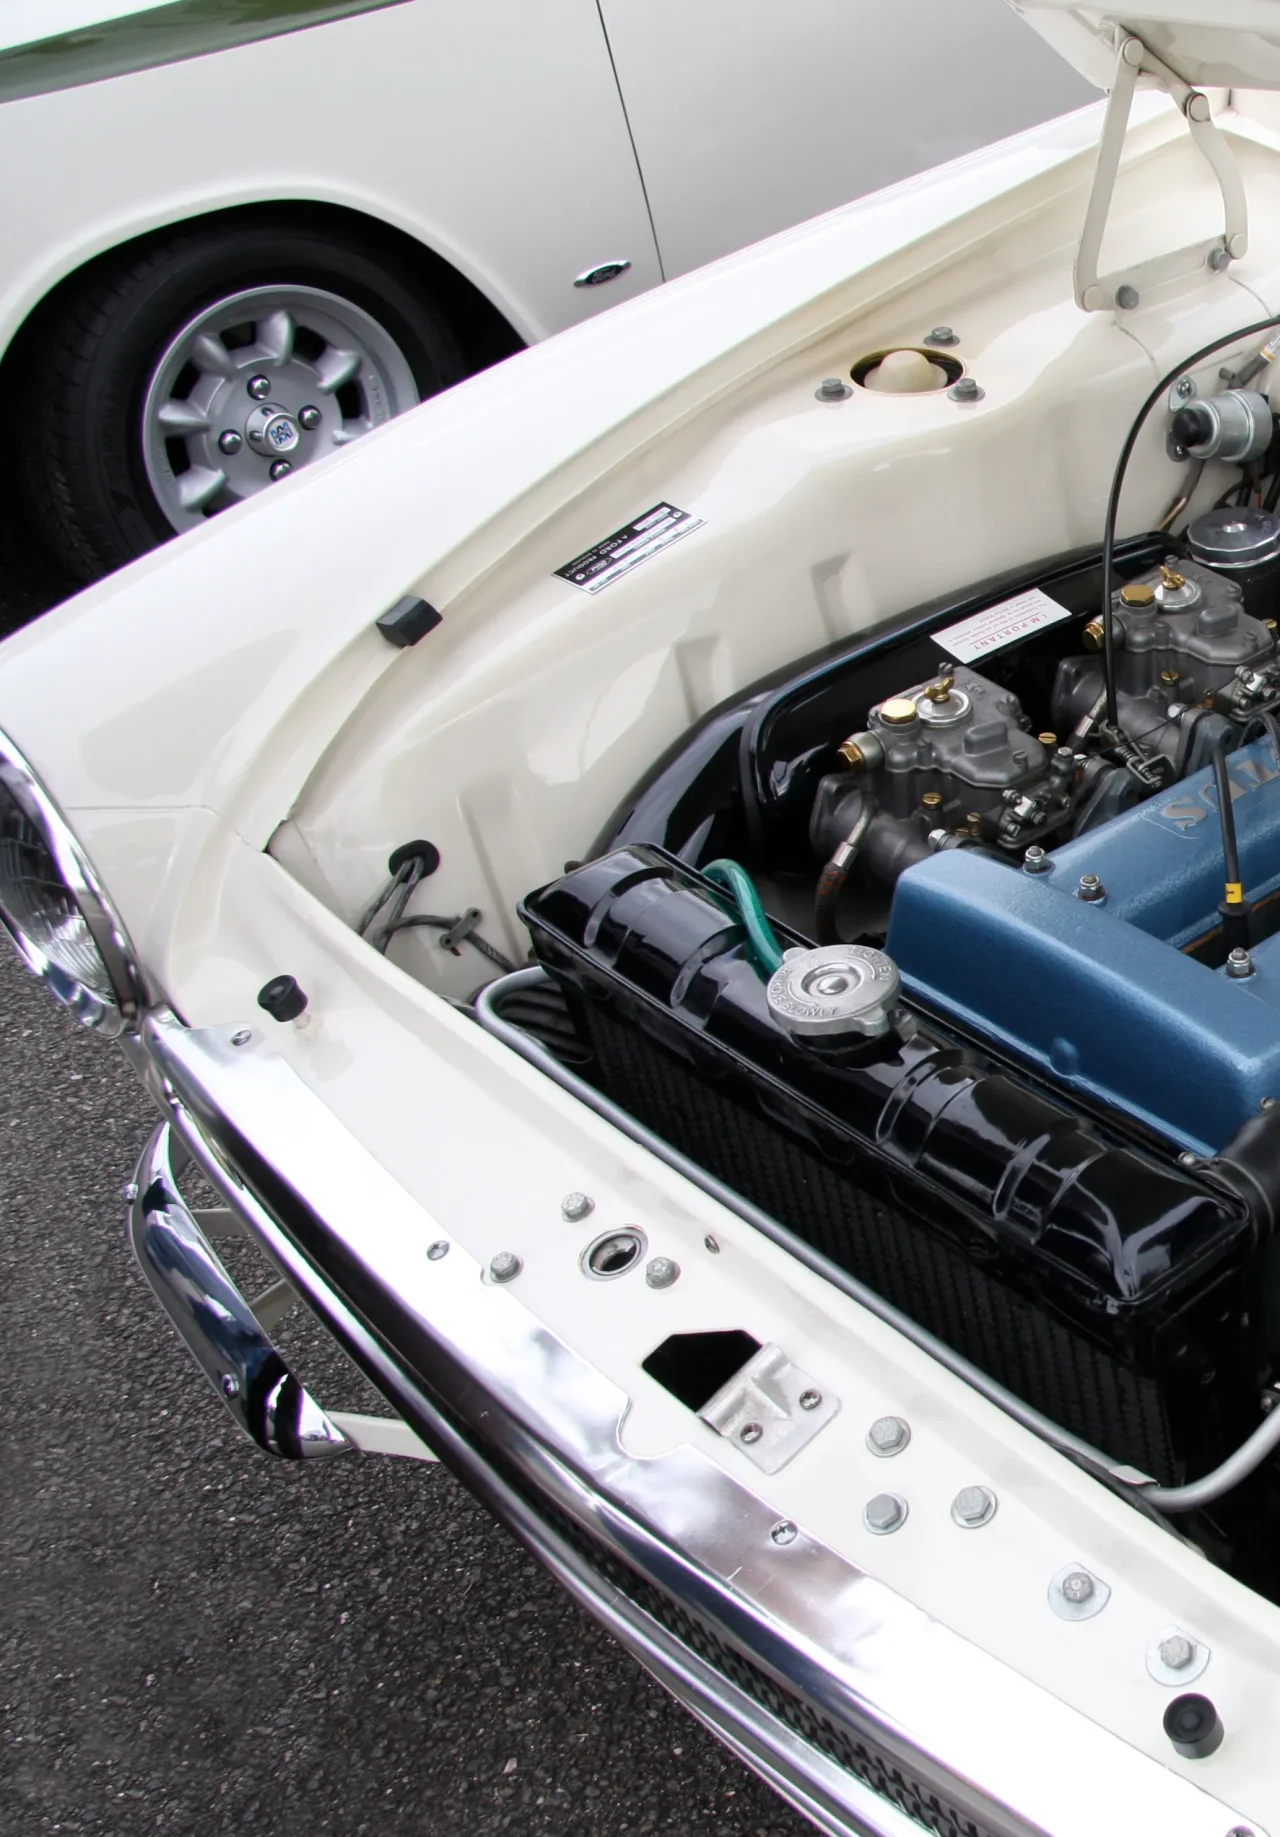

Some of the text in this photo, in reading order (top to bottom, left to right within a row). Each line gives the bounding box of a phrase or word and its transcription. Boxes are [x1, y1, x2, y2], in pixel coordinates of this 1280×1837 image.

[599, 540, 623, 555] FORD
[564, 555, 597, 577] PRODUCT
[975, 614, 1048, 651] IMPORTANT
[782, 1002, 837, 1017] SLOWLY
